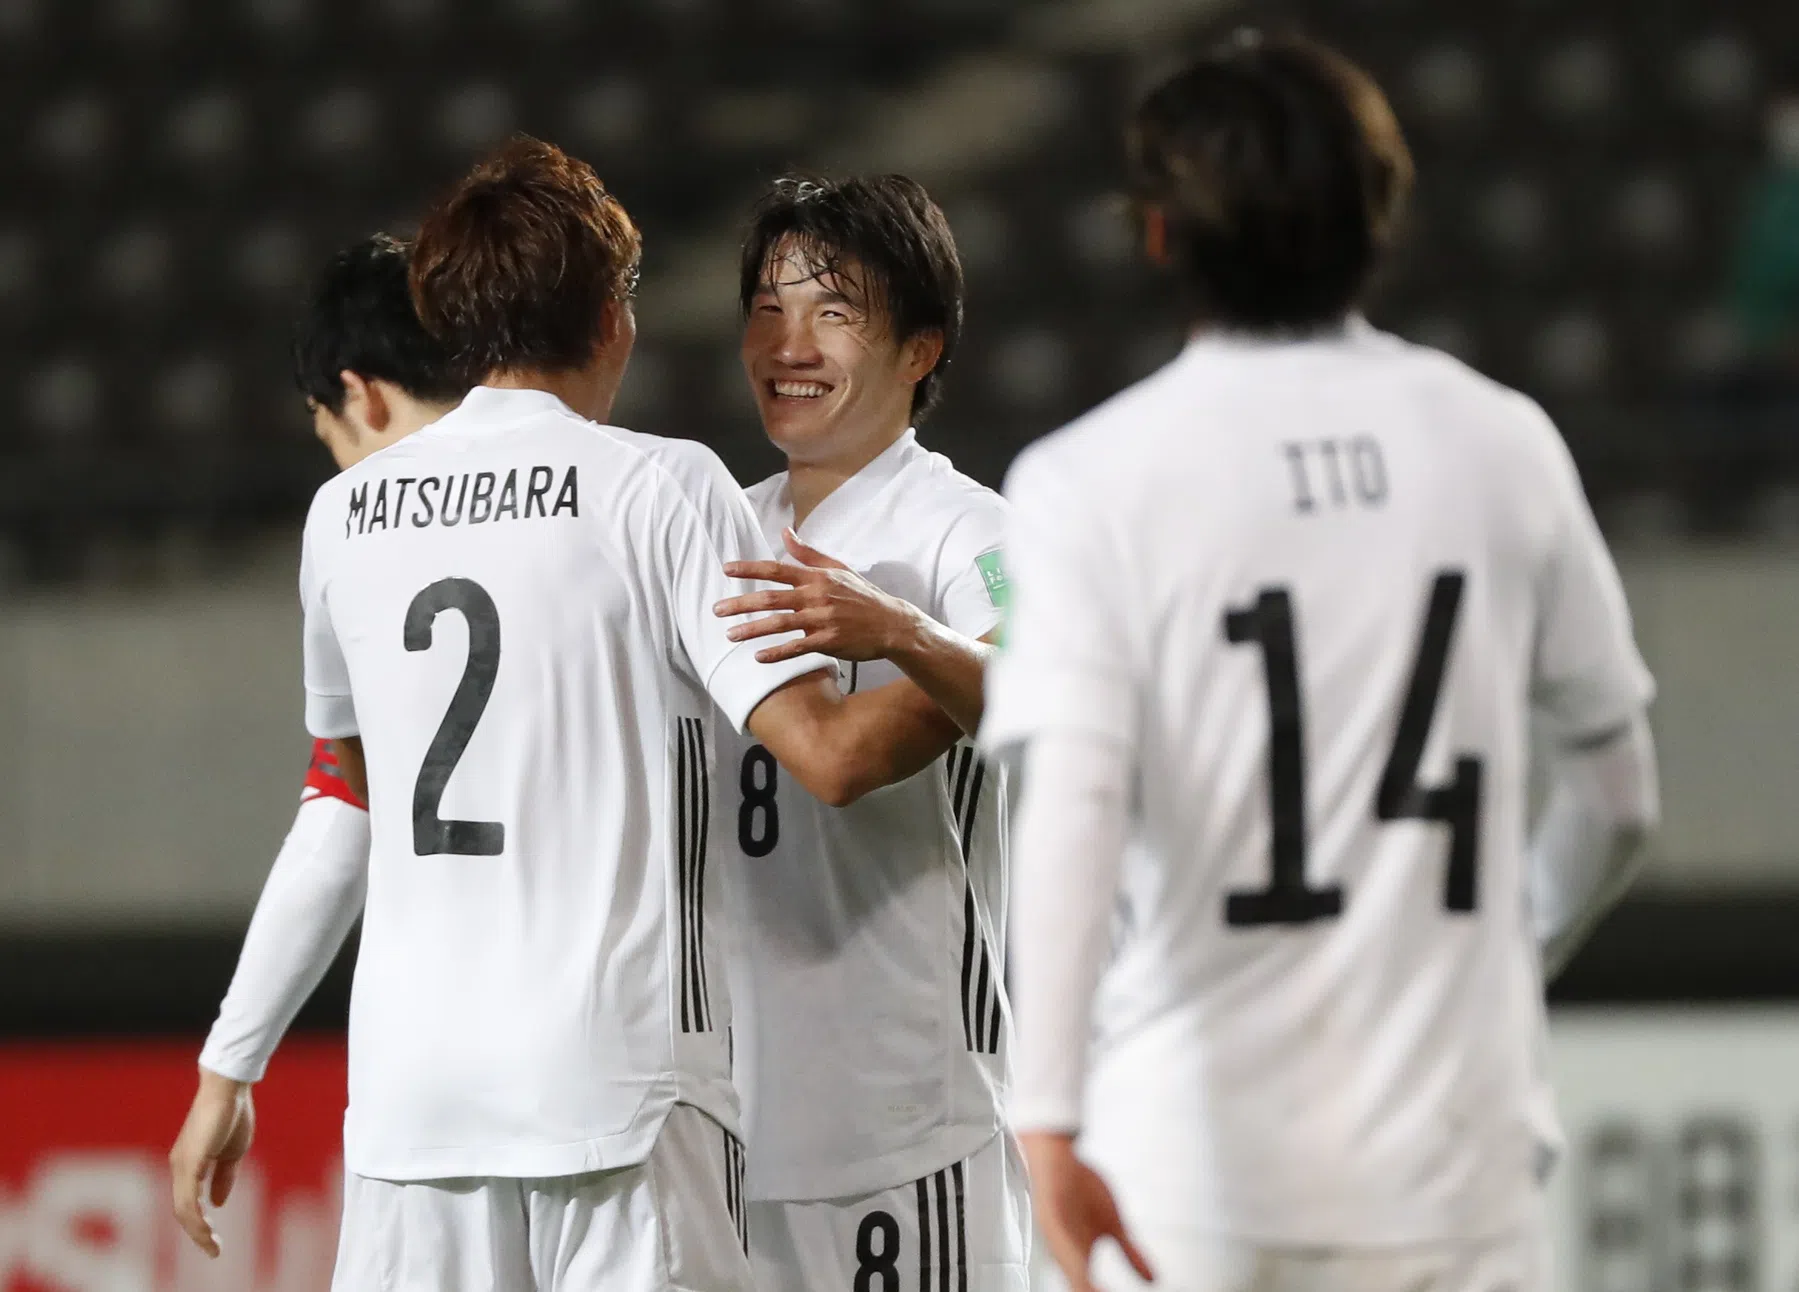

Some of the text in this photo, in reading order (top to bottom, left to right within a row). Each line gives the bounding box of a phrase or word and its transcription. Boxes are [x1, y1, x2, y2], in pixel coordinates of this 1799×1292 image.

[346, 464, 579, 539] MATSUBARA
[1283, 434, 1389, 514] ITO
[403, 576, 505, 857] 2
[1222, 569, 1484, 926] 14
[738, 744, 780, 858] 8
[853, 1211, 900, 1292] 8
